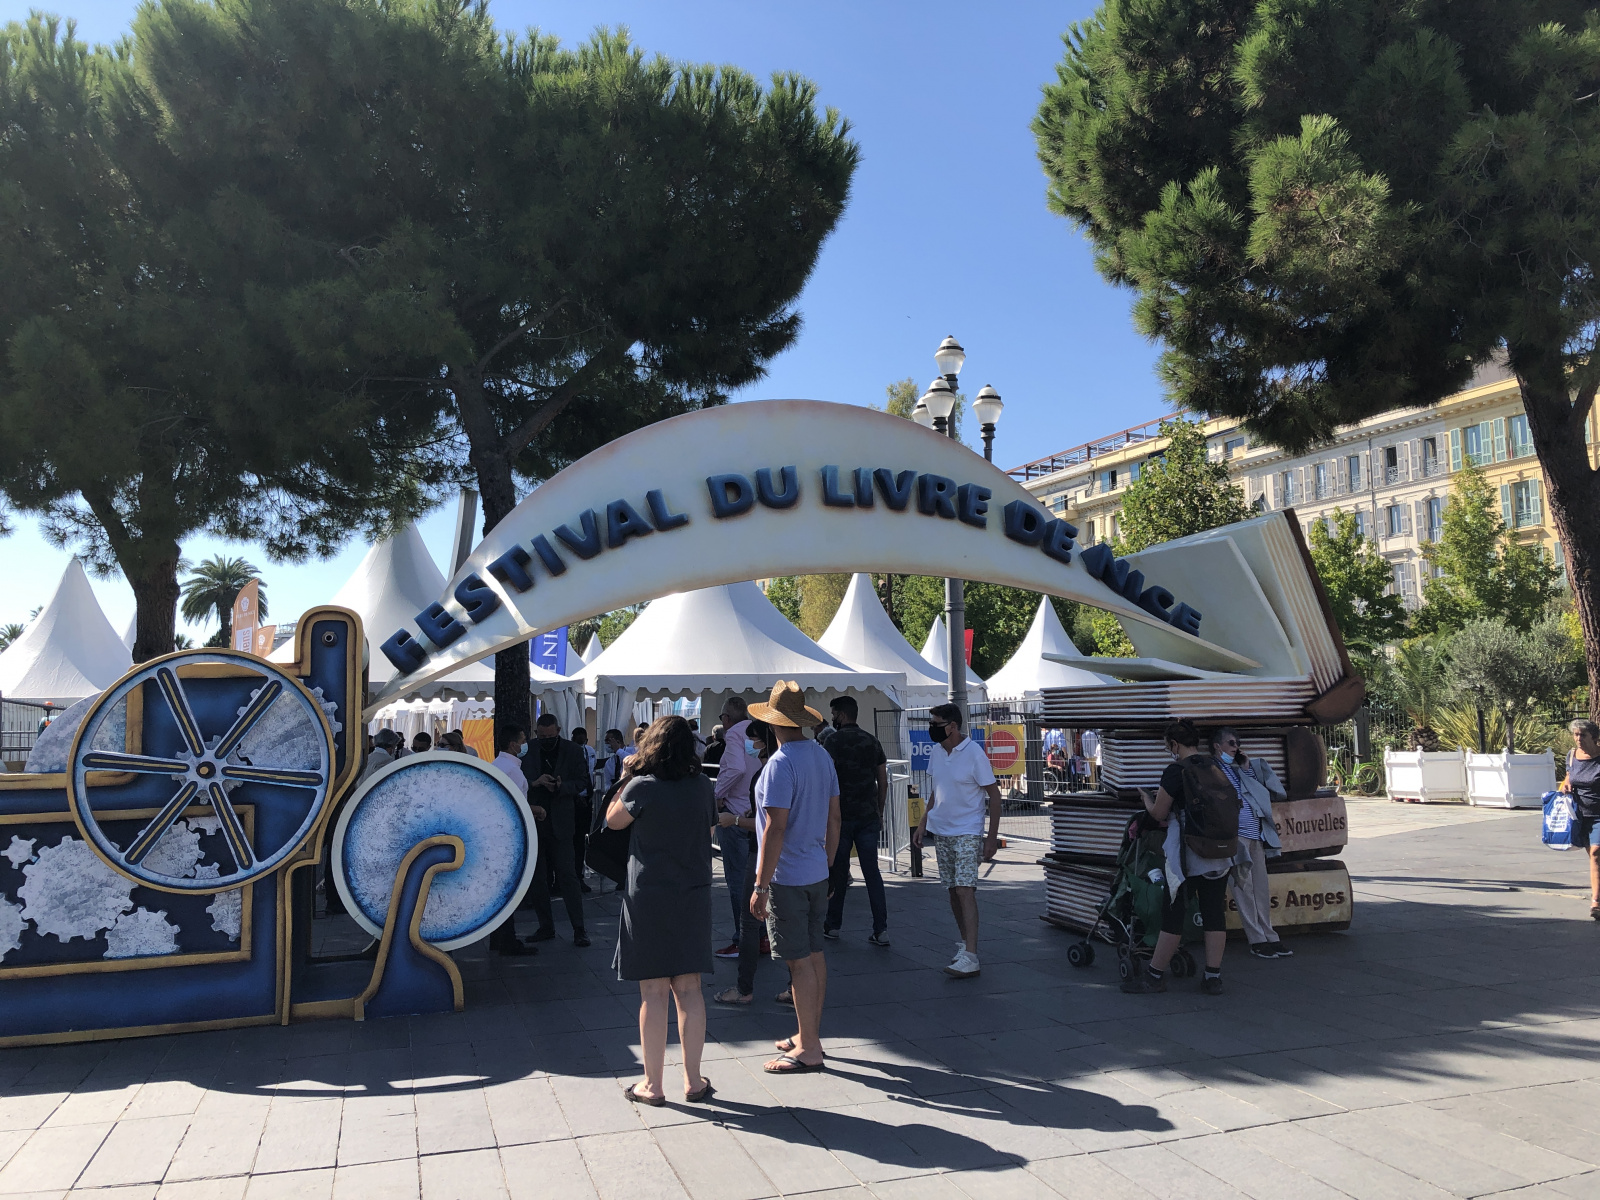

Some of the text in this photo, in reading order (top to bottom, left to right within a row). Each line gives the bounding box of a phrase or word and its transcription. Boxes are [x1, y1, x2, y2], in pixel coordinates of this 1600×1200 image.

[380, 464, 1202, 675] FESTIVAL DU LIVRE DE NICE
[1285, 812, 1346, 836] Nouvelles
[1285, 889, 1346, 911] Anges
